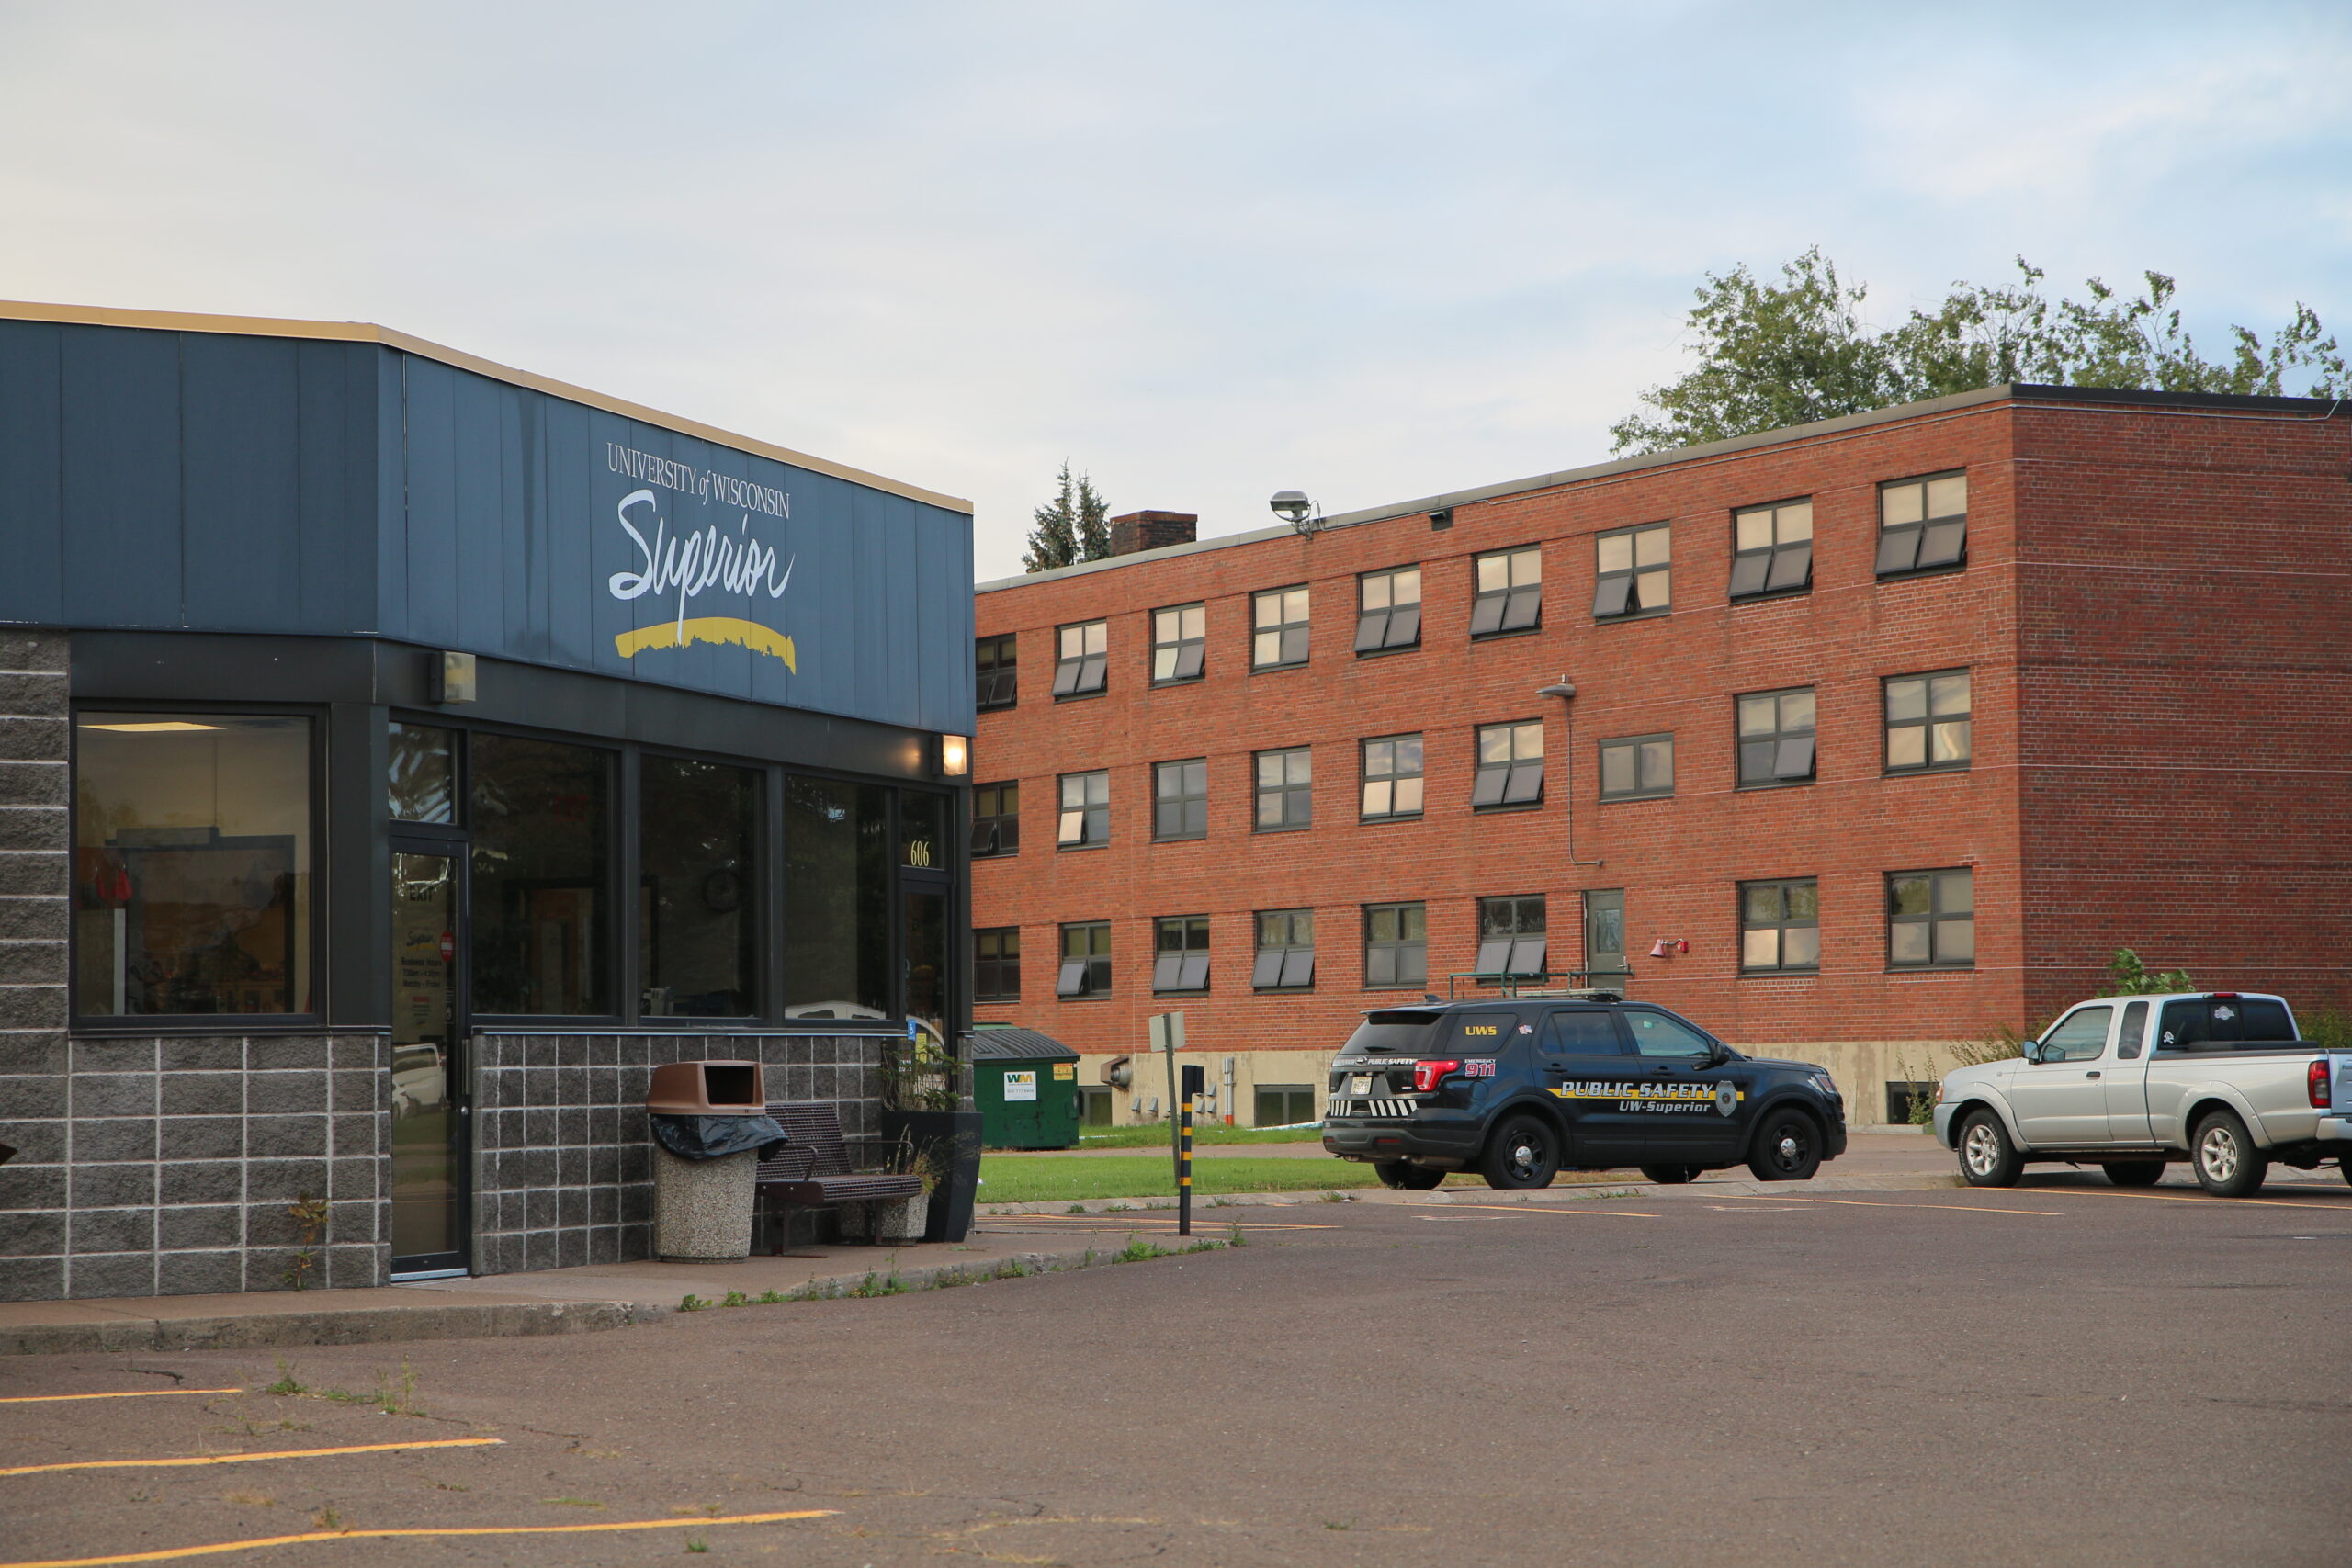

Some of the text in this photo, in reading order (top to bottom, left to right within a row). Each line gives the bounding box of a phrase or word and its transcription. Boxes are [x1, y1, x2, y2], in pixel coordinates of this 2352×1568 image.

[606, 442, 790, 521] UNIVERSITY of WISCONSIN
[608, 489, 796, 646] Superior
[910, 840, 930, 867] 606
[409, 886, 434, 902] EXIT
[1464, 1026, 1498, 1035] UWS
[1464, 1063, 1496, 1077] 911
[1007, 1074, 1033, 1083] WM
[1561, 1081, 1714, 1098] PUBLIC SAFETY
[1619, 1100, 1711, 1114] UW-Superior
